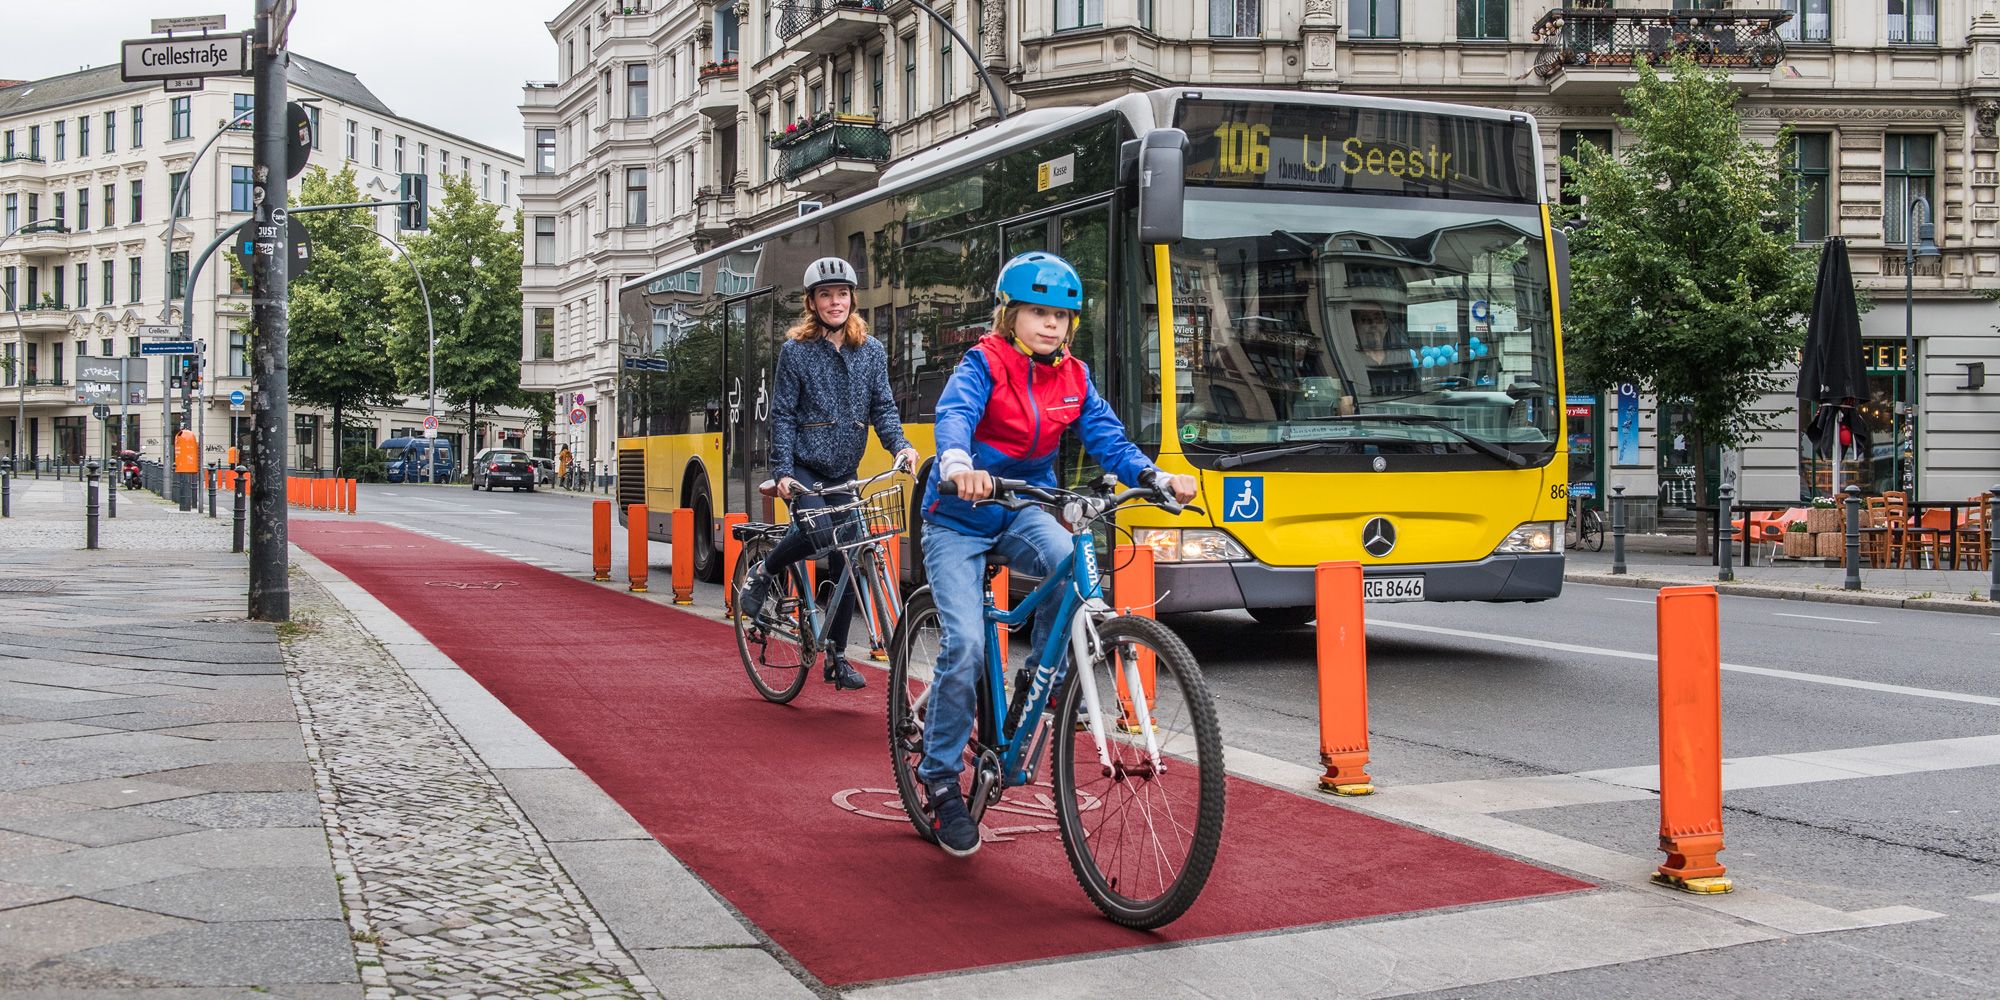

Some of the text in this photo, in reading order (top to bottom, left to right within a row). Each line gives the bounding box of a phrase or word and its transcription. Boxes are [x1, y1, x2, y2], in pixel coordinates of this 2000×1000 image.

[142, 44, 228, 67] Crellestraße
[187, 79, 194, 87] 48
[1214, 121, 1461, 180] 106 U Seestr.
[1053, 166, 1068, 177] Kasse
[258, 226, 278, 236] JUST
[1174, 325, 1204, 335] Wiedr
[1083, 541, 1099, 587] woom
[1364, 580, 1422, 598] RG 8646
